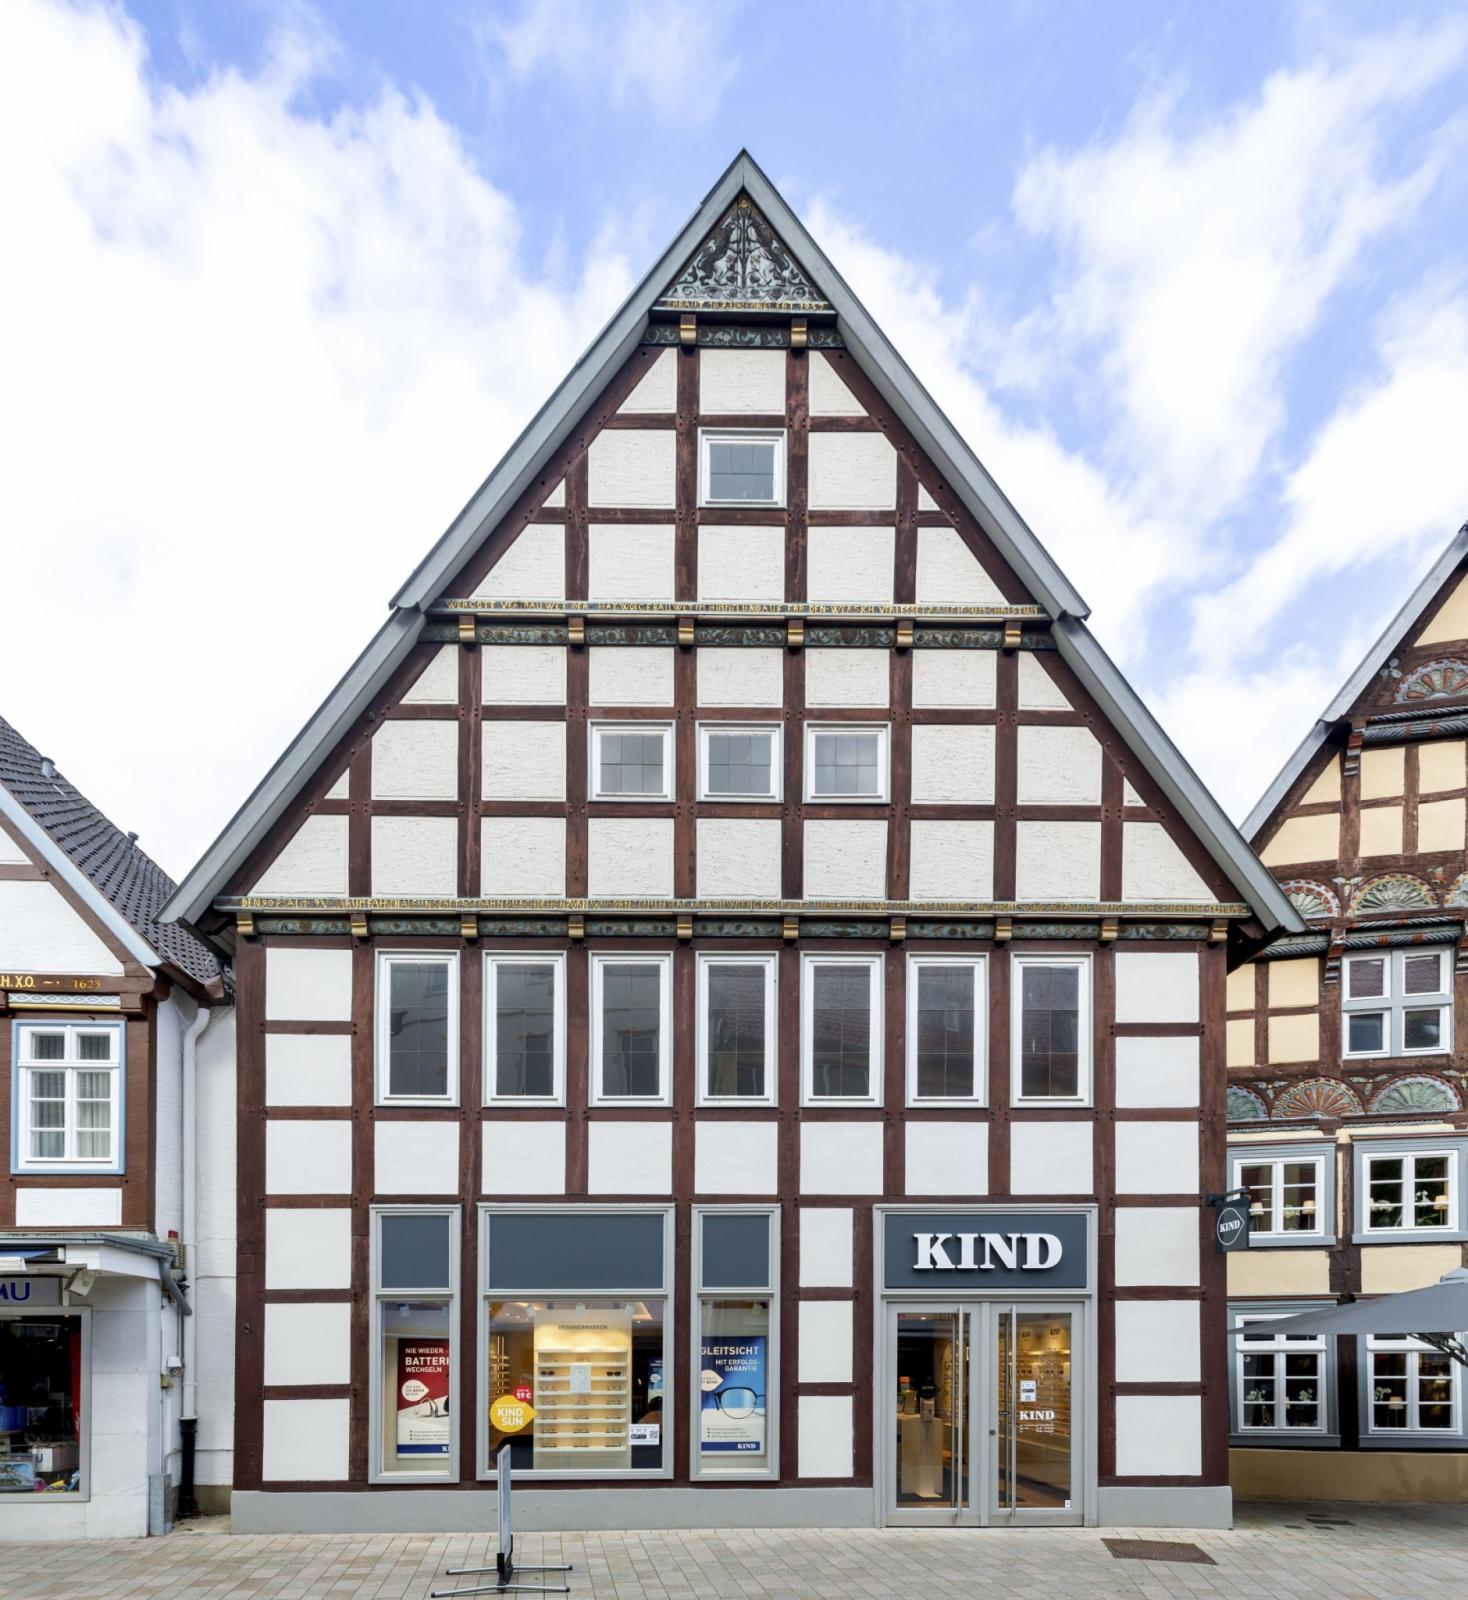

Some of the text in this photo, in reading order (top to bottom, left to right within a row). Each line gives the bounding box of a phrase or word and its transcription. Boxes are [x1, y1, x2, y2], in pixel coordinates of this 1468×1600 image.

[1220, 1220, 1240, 1233] KIND
[913, 1233, 1063, 1269] KIND
[701, 1346, 760, 1355] GLEITSICHT
[497, 1408, 523, 1417] KIND
[1020, 1410, 1055, 1420] KIND
[501, 1417, 523, 1426] SUN
